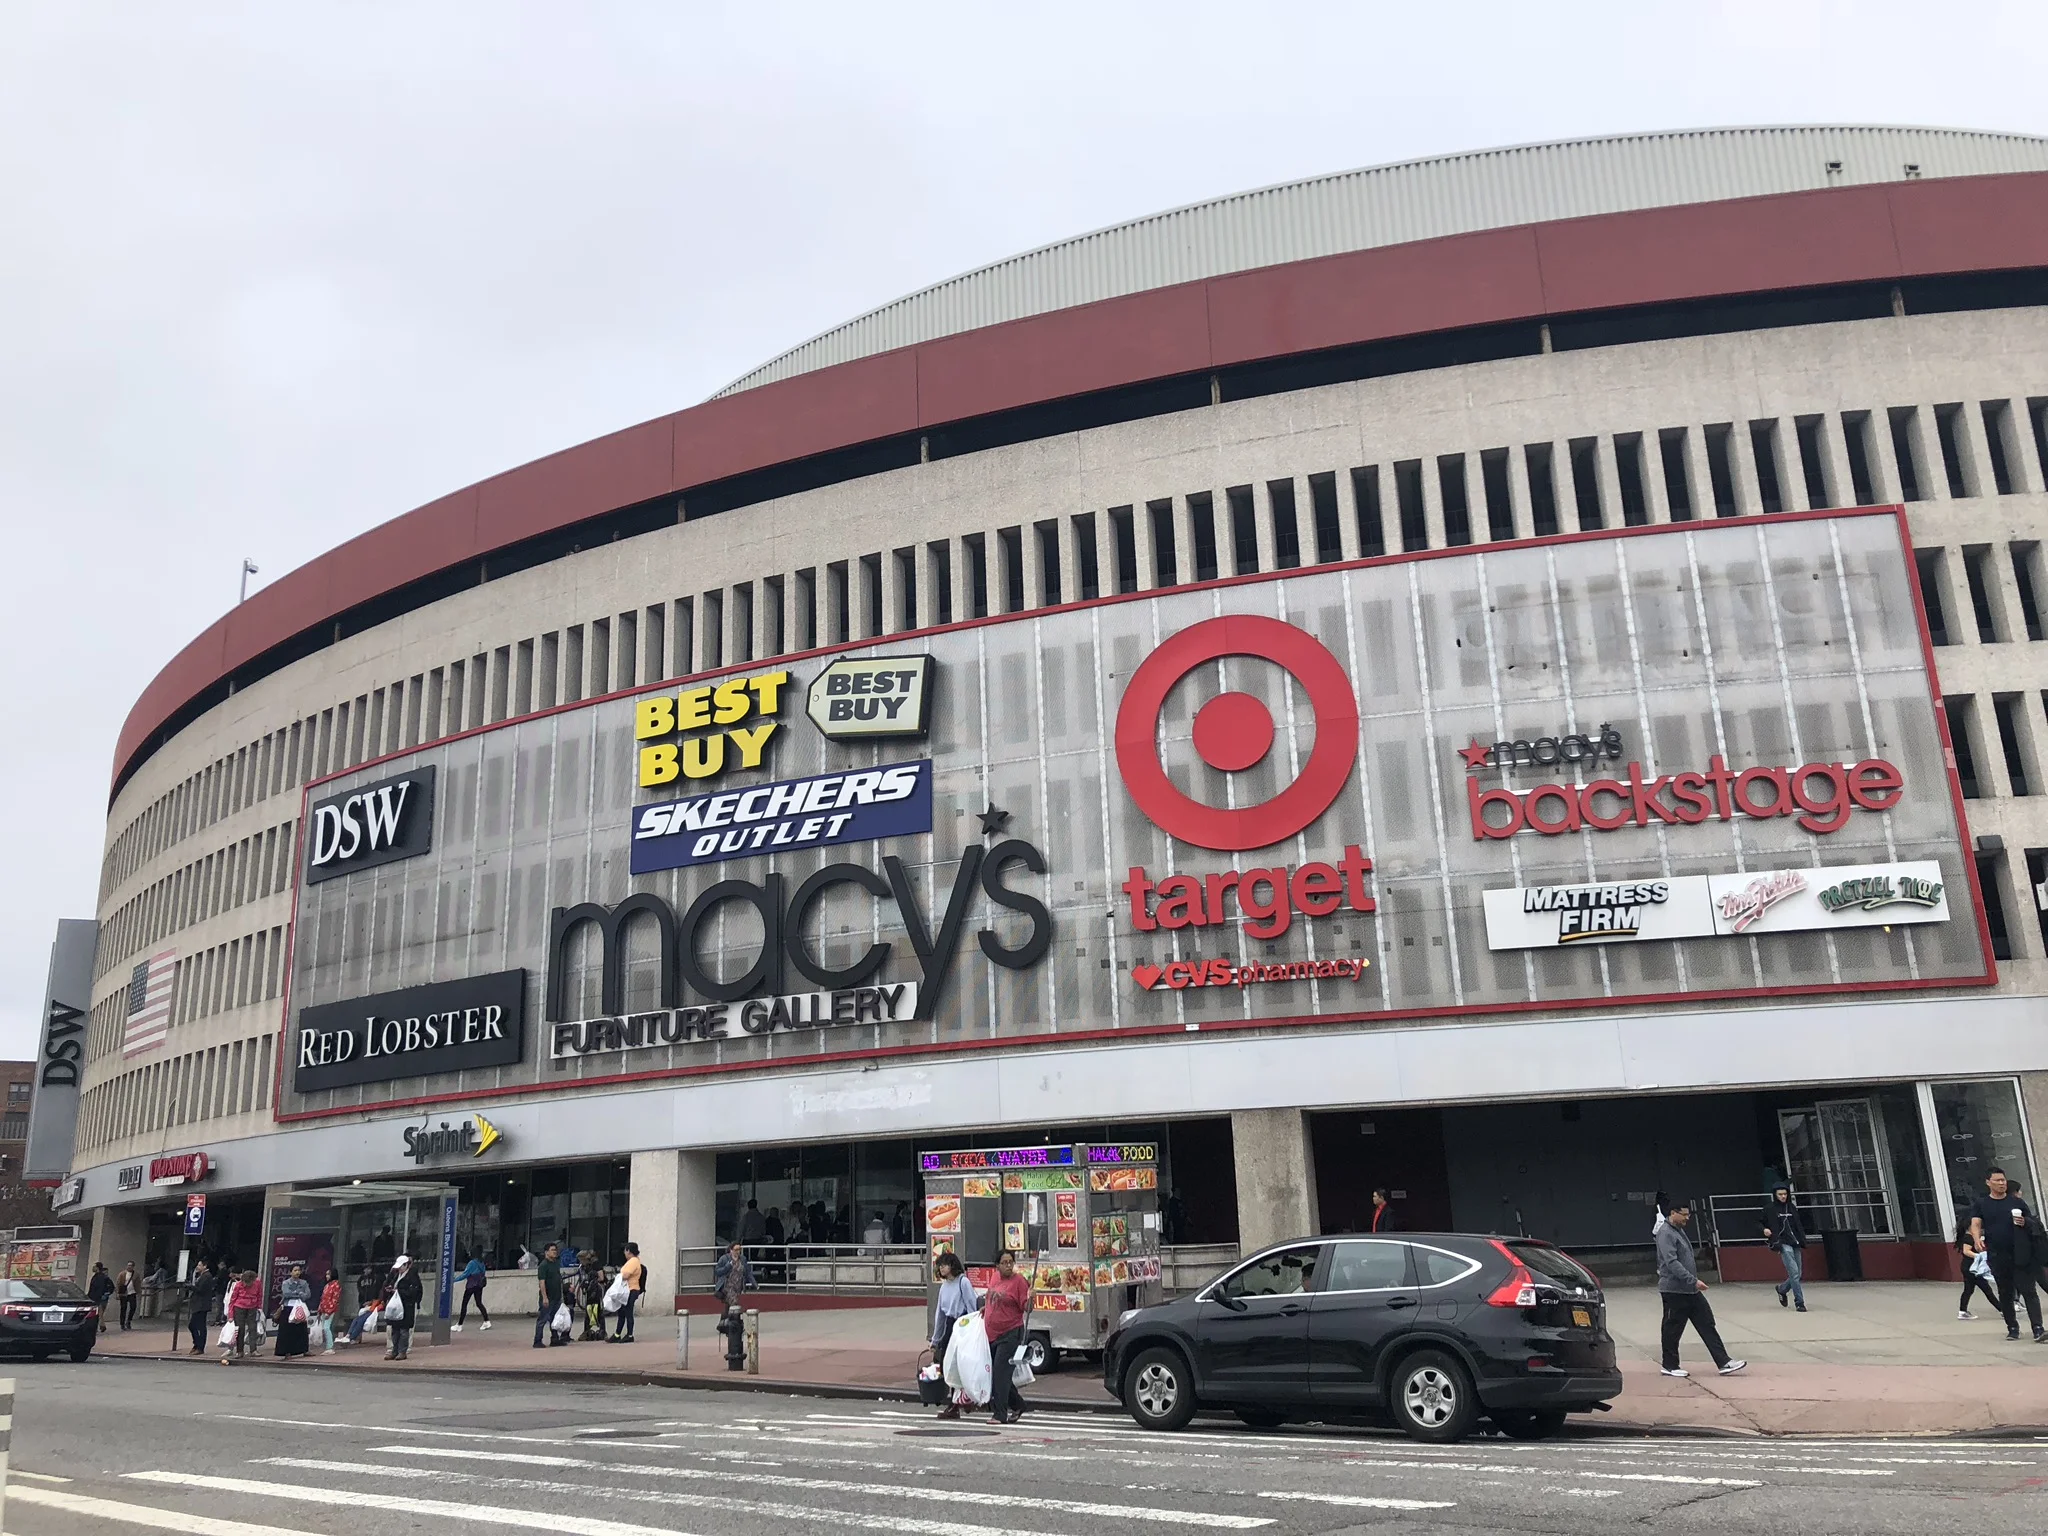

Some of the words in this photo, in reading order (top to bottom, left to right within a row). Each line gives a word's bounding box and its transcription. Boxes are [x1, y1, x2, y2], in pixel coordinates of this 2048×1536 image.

[635, 671, 788, 739] BEST
[826, 670, 917, 696] BEST
[828, 697, 909, 721] BUY
[639, 723, 778, 788] BUY
[635, 765, 920, 840] SKECHERS
[1466, 754, 1904, 841] backstage
[311, 780, 411, 867] DSW
[691, 813, 852, 857] OUTLET
[1122, 844, 1376, 939] target
[1523, 882, 1669, 912] MATTRESS
[1818, 876, 1895, 911] PRETZEL
[1560, 906, 1642, 934] FIRM
[1164, 958, 1232, 989] CVS
[1237, 958, 1364, 989] pharmacy
[298, 1027, 354, 1069] RED
[364, 1004, 503, 1058] LOBSTER
[554, 1004, 729, 1055] FURNITURE
[741, 984, 906, 1032] GALLERY
[42, 999, 86, 1088] DSW
[403, 1120, 475, 1164] Sprint
[1123, 1147, 1154, 1160] FOOD
[167, 1154, 192, 1178] STONE
[445, 1206, 453, 1233] Queens
[441, 1267, 449, 1293] Avenue
